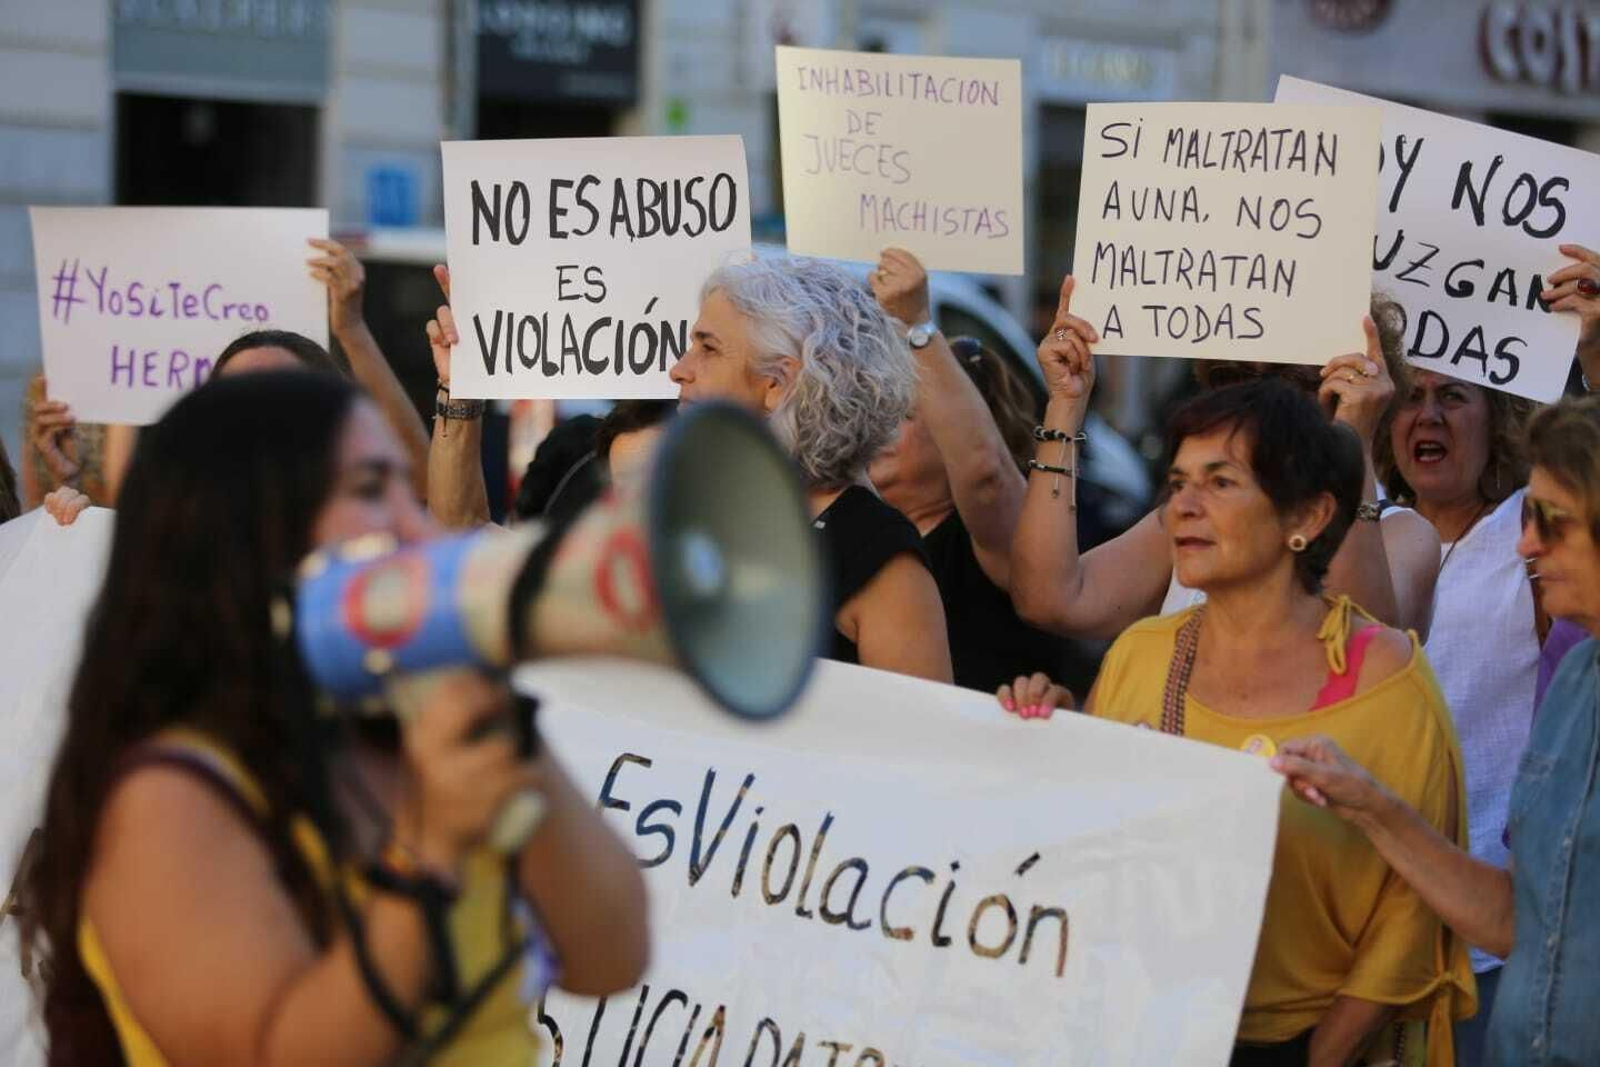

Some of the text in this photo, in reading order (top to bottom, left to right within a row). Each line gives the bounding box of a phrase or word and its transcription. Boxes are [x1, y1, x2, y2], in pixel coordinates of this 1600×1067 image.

[798, 66, 999, 107] INHABILITACION
[846, 108, 883, 136] DE
[802, 133, 912, 185] JUECES
[1162, 126, 1338, 177] MALTRATAN
[470, 172, 738, 246] NO ES ABUSO
[1378, 133, 1571, 239] Y NOS
[859, 192, 1010, 240] MACHISTAS
[1235, 195, 1323, 239] NOS
[555, 264, 608, 304] ES
[1091, 240, 1297, 298] MALTRATAN
[471, 296, 689, 377] VIOLACIÓN
[1102, 302, 1265, 344] A TODAS
